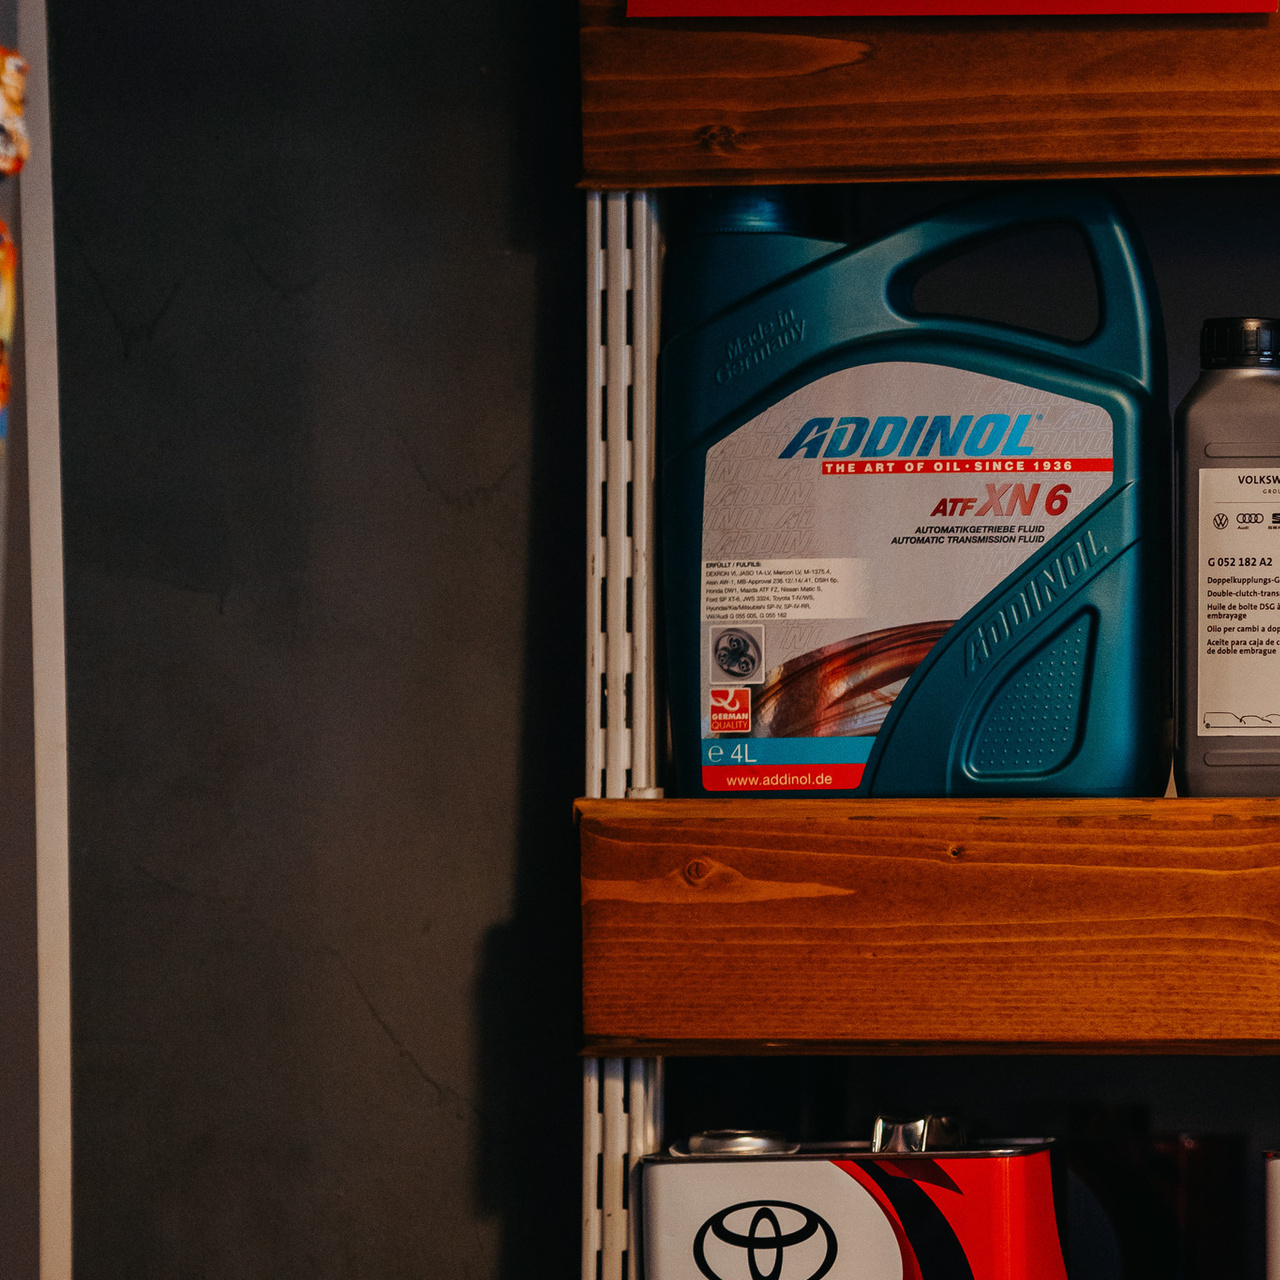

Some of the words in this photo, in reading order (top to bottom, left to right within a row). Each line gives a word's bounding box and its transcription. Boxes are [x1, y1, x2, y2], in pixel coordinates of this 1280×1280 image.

[778, 413, 1034, 459] ADDINOL
[825, 462, 855, 473] THE
[864, 462, 895, 473] ART
[905, 462, 924, 472] OF
[1032, 460, 1072, 471] 1936
[1044, 483, 1071, 516] 6
[915, 525, 1015, 535] AUTOMATIKGETRIEBE
[1018, 524, 1045, 534] FLUID
[891, 536, 944, 545] AUTOMATIC
[947, 535, 1016, 545] TRANSMISSION
[1018, 535, 1045, 543] FLUID
[1208, 558, 1215, 567] G
[1217, 558, 1235, 567] 052
[1239, 558, 1256, 567] 182
[1260, 558, 1272, 567] A2
[1260, 603, 1275, 611] DSG
[1207, 612, 1247, 620] embrayage
[712, 712, 748, 721] GERMAN
[711, 720, 748, 730] QUALITY
[730, 743, 757, 763] 4L
[726, 773, 832, 787] www.addinol.de
